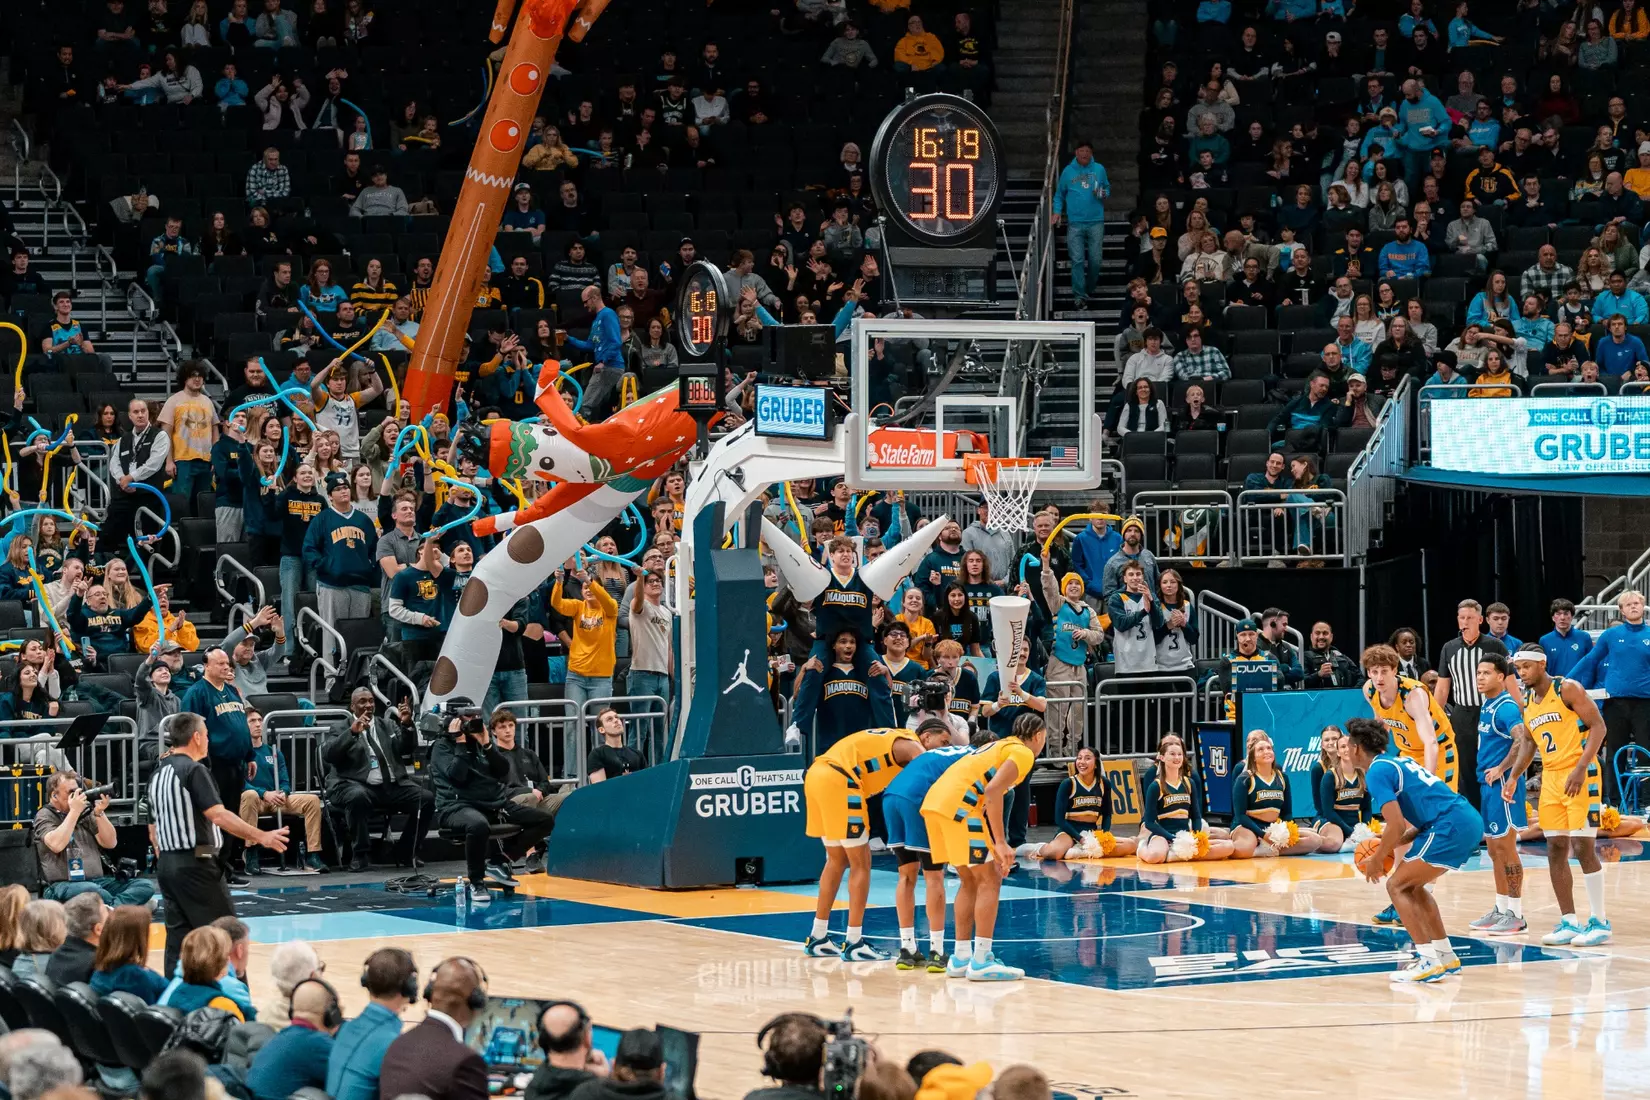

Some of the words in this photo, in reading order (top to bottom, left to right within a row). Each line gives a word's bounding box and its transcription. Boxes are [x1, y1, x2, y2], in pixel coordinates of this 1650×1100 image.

[914, 128, 979, 160] 16:19
[909, 163, 974, 220] 30
[692, 315, 712, 344] 30
[336, 414, 351, 426] 77
[759, 395, 824, 425] GRUBER
[1534, 412, 1558, 422] ONE
[1561, 411, 1590, 422] CALL
[1585, 463, 1630, 471] OFFICES
[331, 525, 366, 545] MARQUETTE
[45, 556, 55, 568] 3
[416, 579, 438, 601] MU
[826, 591, 866, 605] MARQUETTE
[87, 615, 123, 627] MARQUETTE
[1136, 621, 1146, 640] 3
[1007, 620, 1023, 668] MARQUETTE
[1169, 632, 1179, 651] 3
[826, 681, 868, 696] MARQUETTE
[215, 701, 246, 717] MARQUETTE
[1529, 712, 1562, 731] MARQUETTE
[1542, 731, 1557, 753] 2
[1209, 746, 1229, 777] MU
[1282, 747, 1321, 772] Mar
[695, 777, 713, 786] ONE
[714, 775, 736, 785] CALL
[741, 768, 751, 788] G
[755, 773, 784, 783] THAT'S
[785, 772, 800, 781] ALL
[1107, 770, 1138, 815] SE
[695, 790, 800, 818] GRUBER
